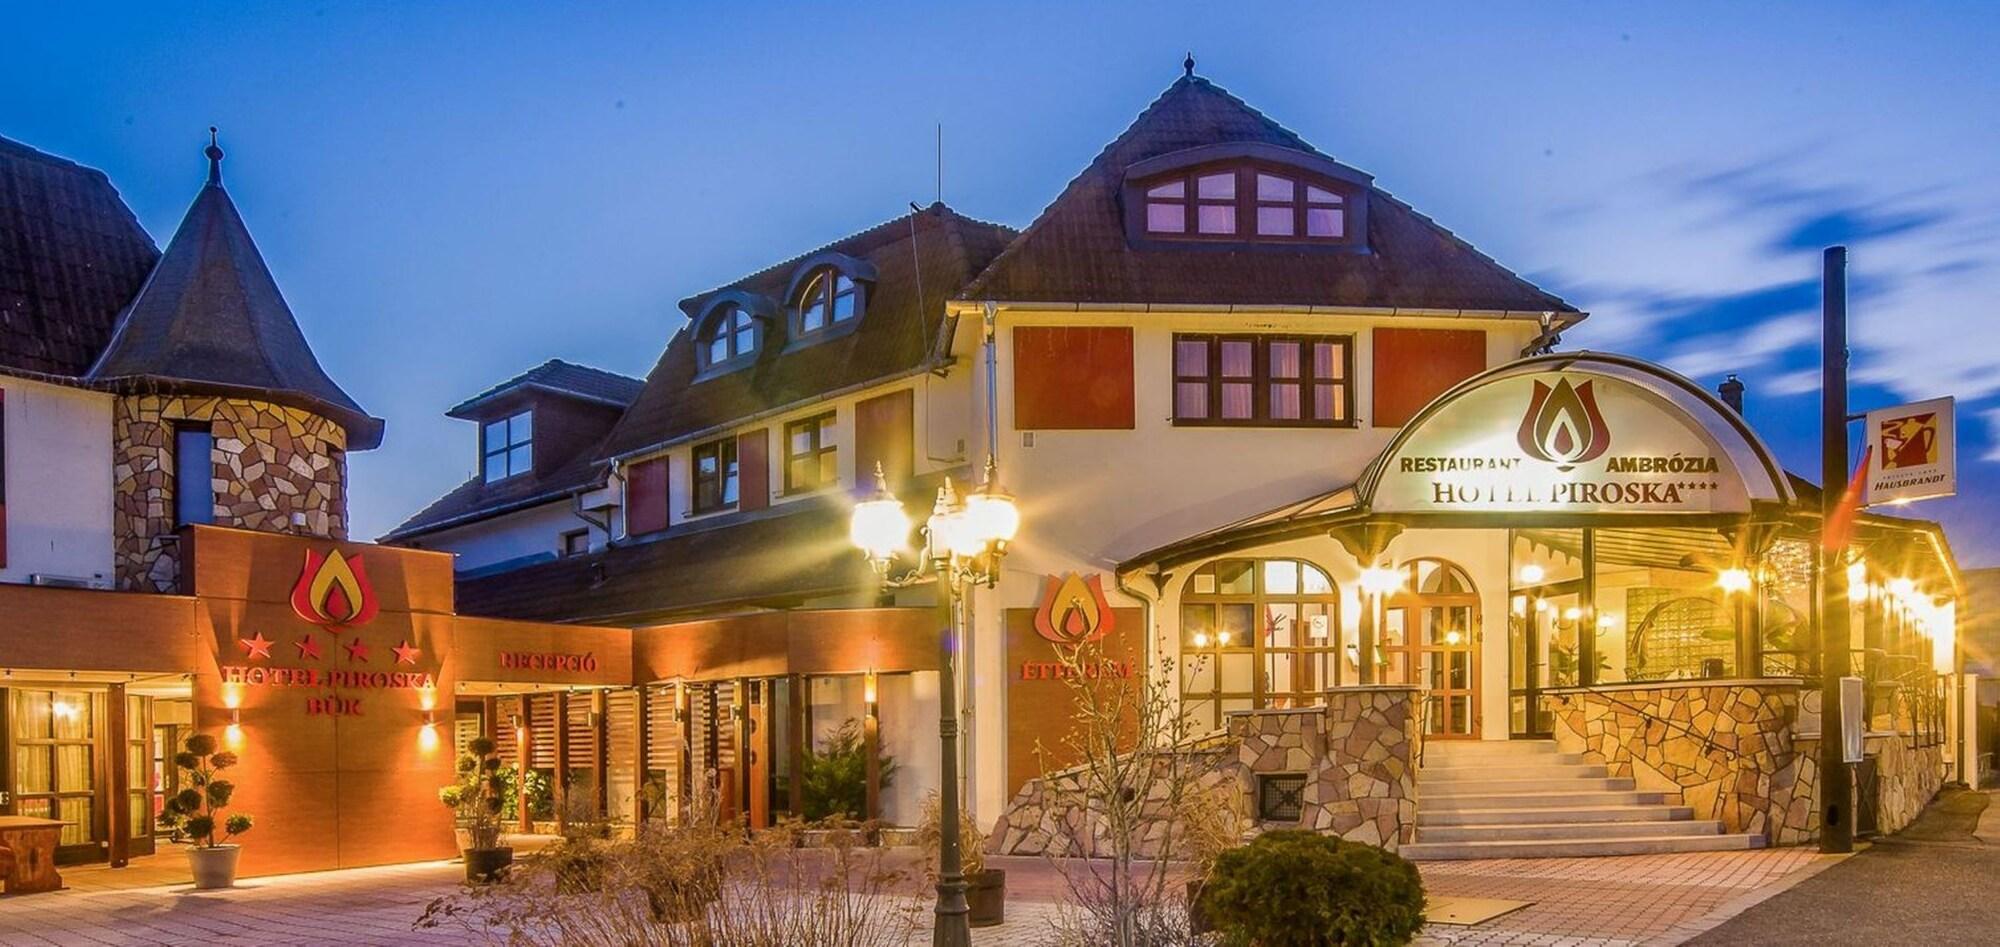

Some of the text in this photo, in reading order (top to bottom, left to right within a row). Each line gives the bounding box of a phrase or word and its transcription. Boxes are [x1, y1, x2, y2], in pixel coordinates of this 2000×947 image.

[1400, 457, 1521, 473] RESTAURANT
[1605, 453, 1719, 473] AMBRÓZIA
[1550, 481, 1682, 504] PIROSKA
[1874, 473, 1946, 491] HAUSBRANDT
[500, 651, 598, 673] RECEPCIÓ
[222, 665, 438, 689] HOTEL PIROSKA
